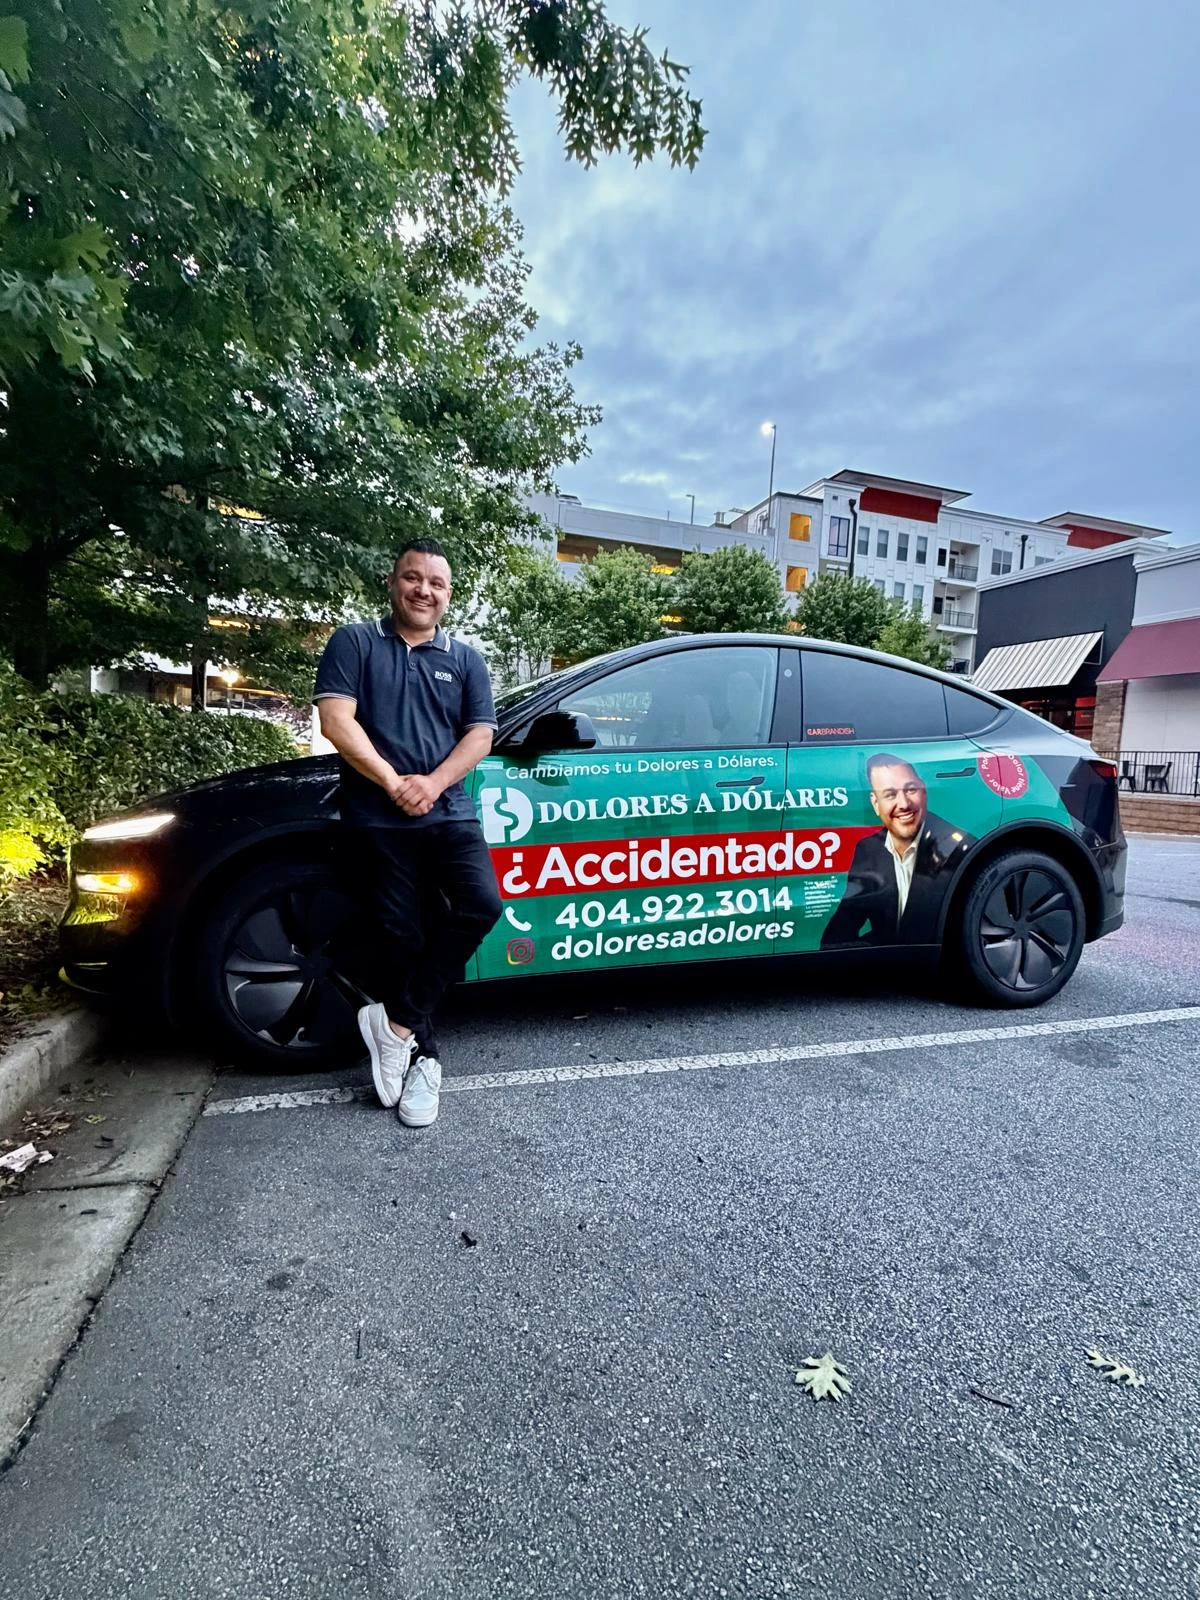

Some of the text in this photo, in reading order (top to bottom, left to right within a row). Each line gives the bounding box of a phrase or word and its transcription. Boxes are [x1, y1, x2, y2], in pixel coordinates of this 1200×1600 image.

[435, 671, 452, 679] BOSS
[506, 755, 778, 780] Cambiamos tu Dolores a Dólares.
[537, 786, 849, 824] DOLORES A DÓLARES
[502, 831, 841, 894] ¿Accidentado?
[555, 886, 793, 929] 404.922.3014
[551, 920, 795, 961] doloresadolores
